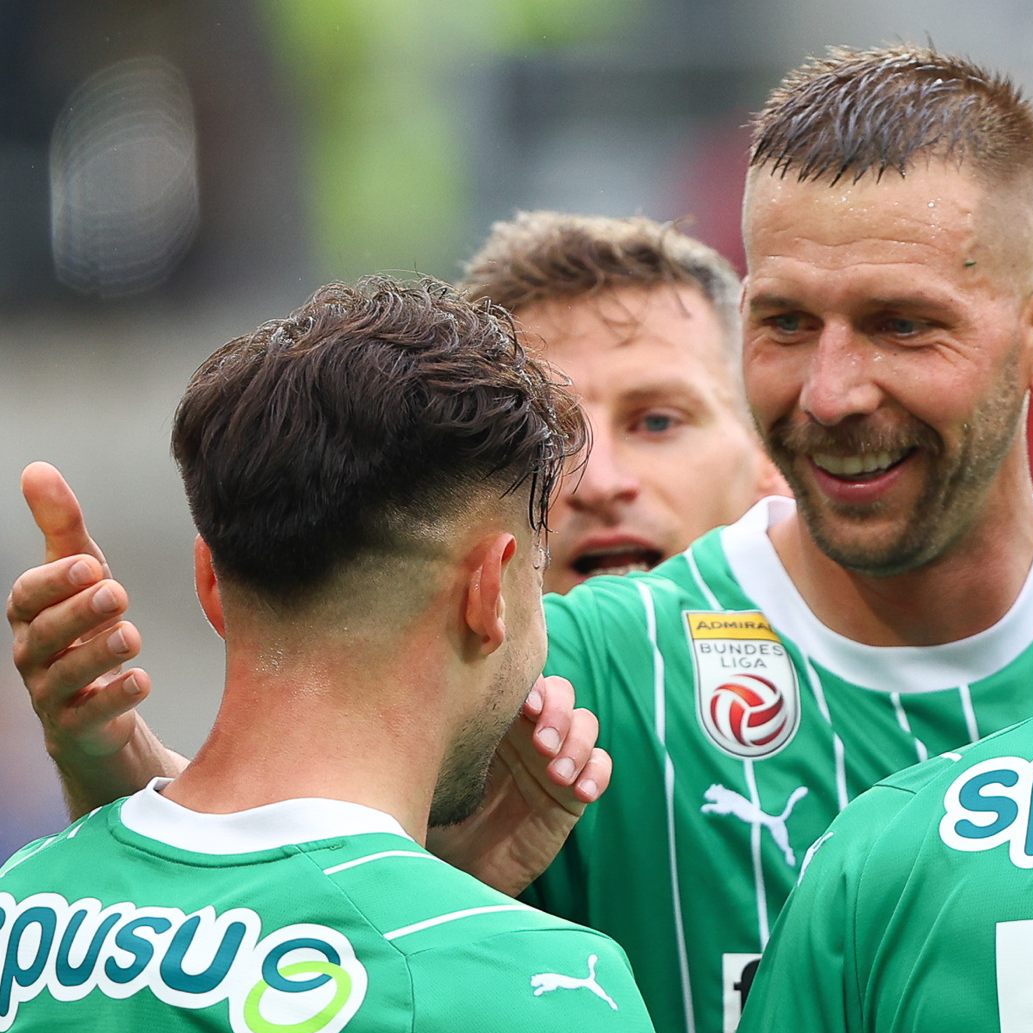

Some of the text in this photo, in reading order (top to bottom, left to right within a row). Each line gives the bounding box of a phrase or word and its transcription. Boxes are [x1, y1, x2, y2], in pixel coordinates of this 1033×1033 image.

[699, 643, 784, 656] BUNDES
[720, 656, 767, 669] LIGA
[0, 906, 247, 1017] pusu
